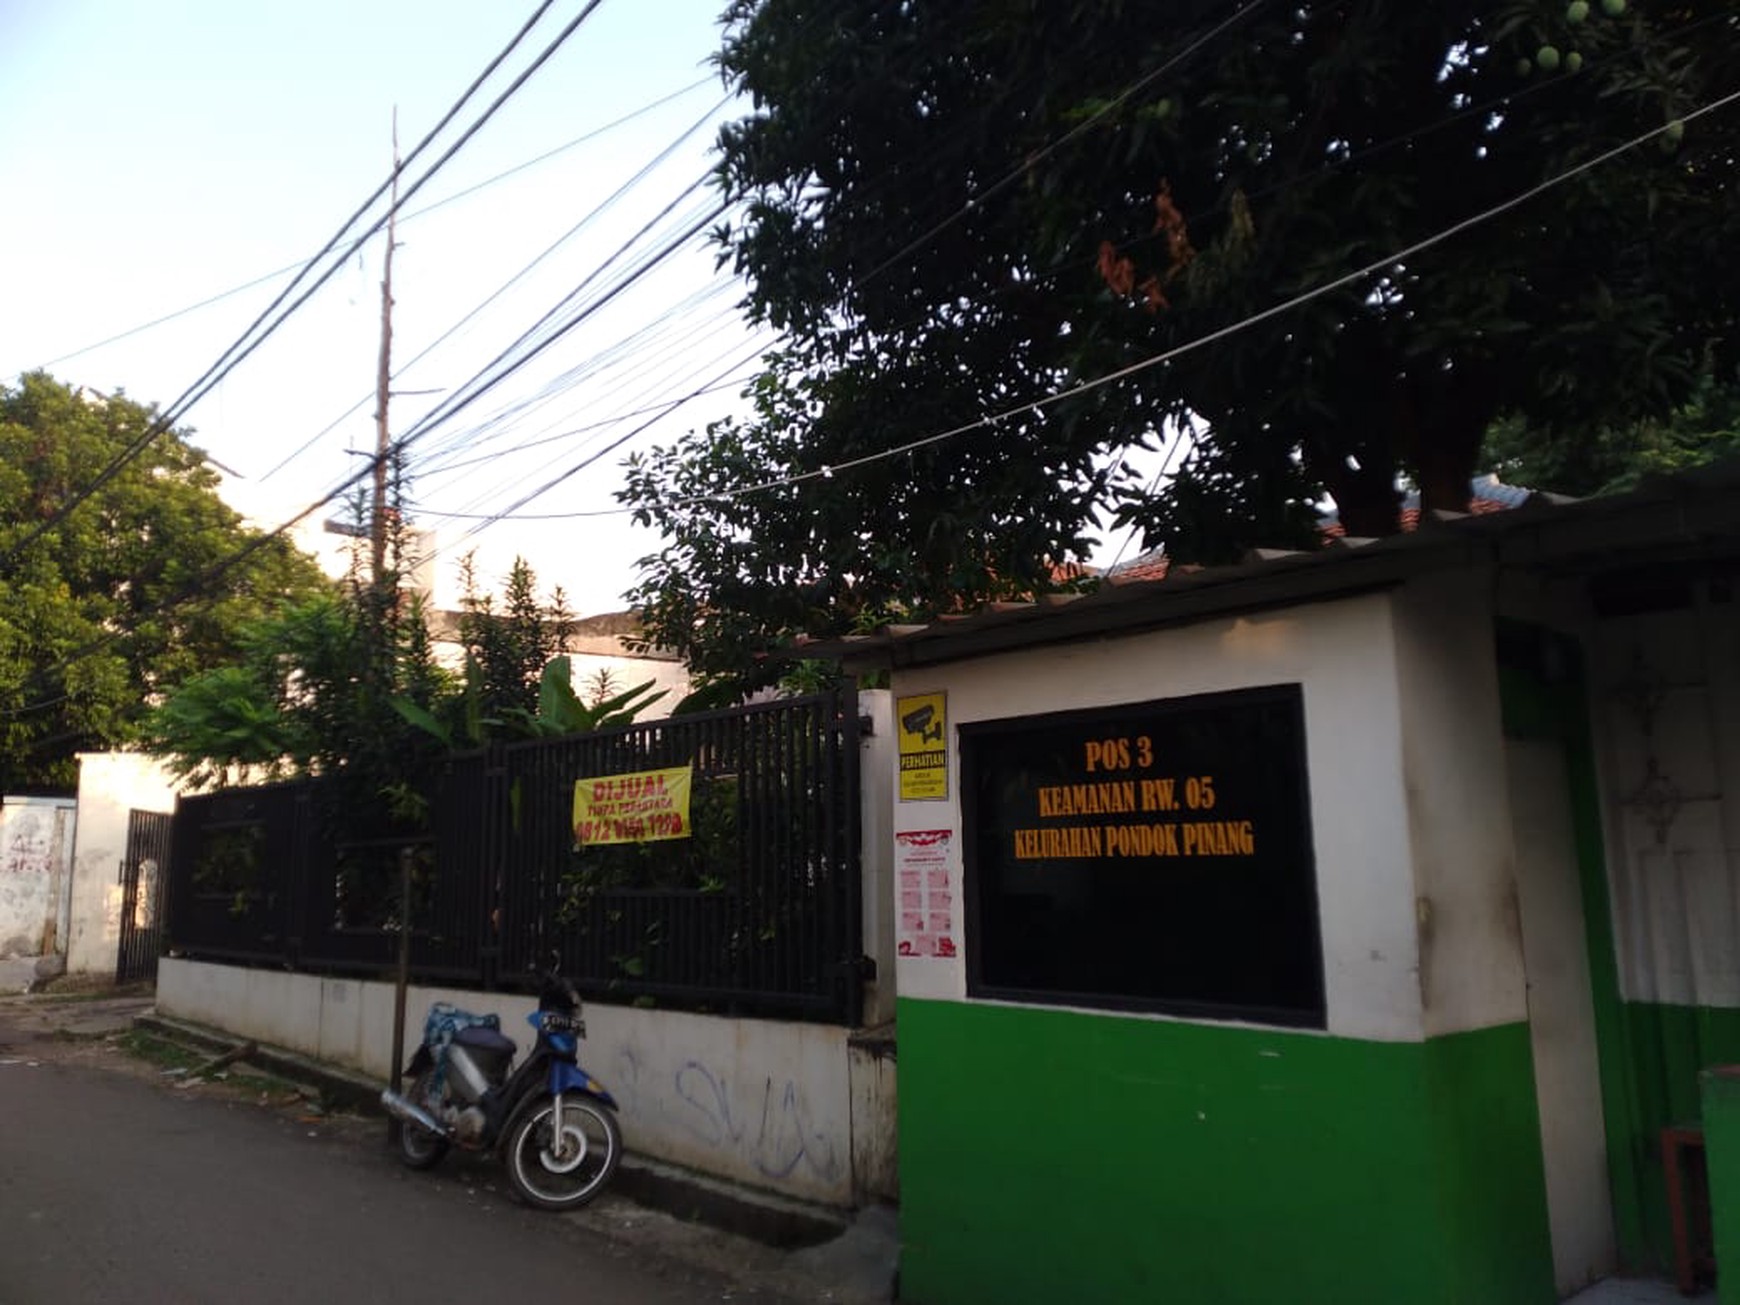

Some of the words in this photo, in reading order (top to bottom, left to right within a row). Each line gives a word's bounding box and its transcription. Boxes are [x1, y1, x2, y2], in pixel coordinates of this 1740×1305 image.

[1086, 738, 1130, 771] POS
[1137, 736, 1153, 767] 3
[593, 775, 668, 801] DIJUAL
[1039, 780, 1136, 816] KEAMANAN
[1140, 778, 1180, 811] RW.
[1186, 776, 1215, 809] 05
[1015, 827, 1102, 859] KELURAHAN
[1105, 823, 1179, 857] PONDOK
[1183, 820, 1254, 855] PINANG
